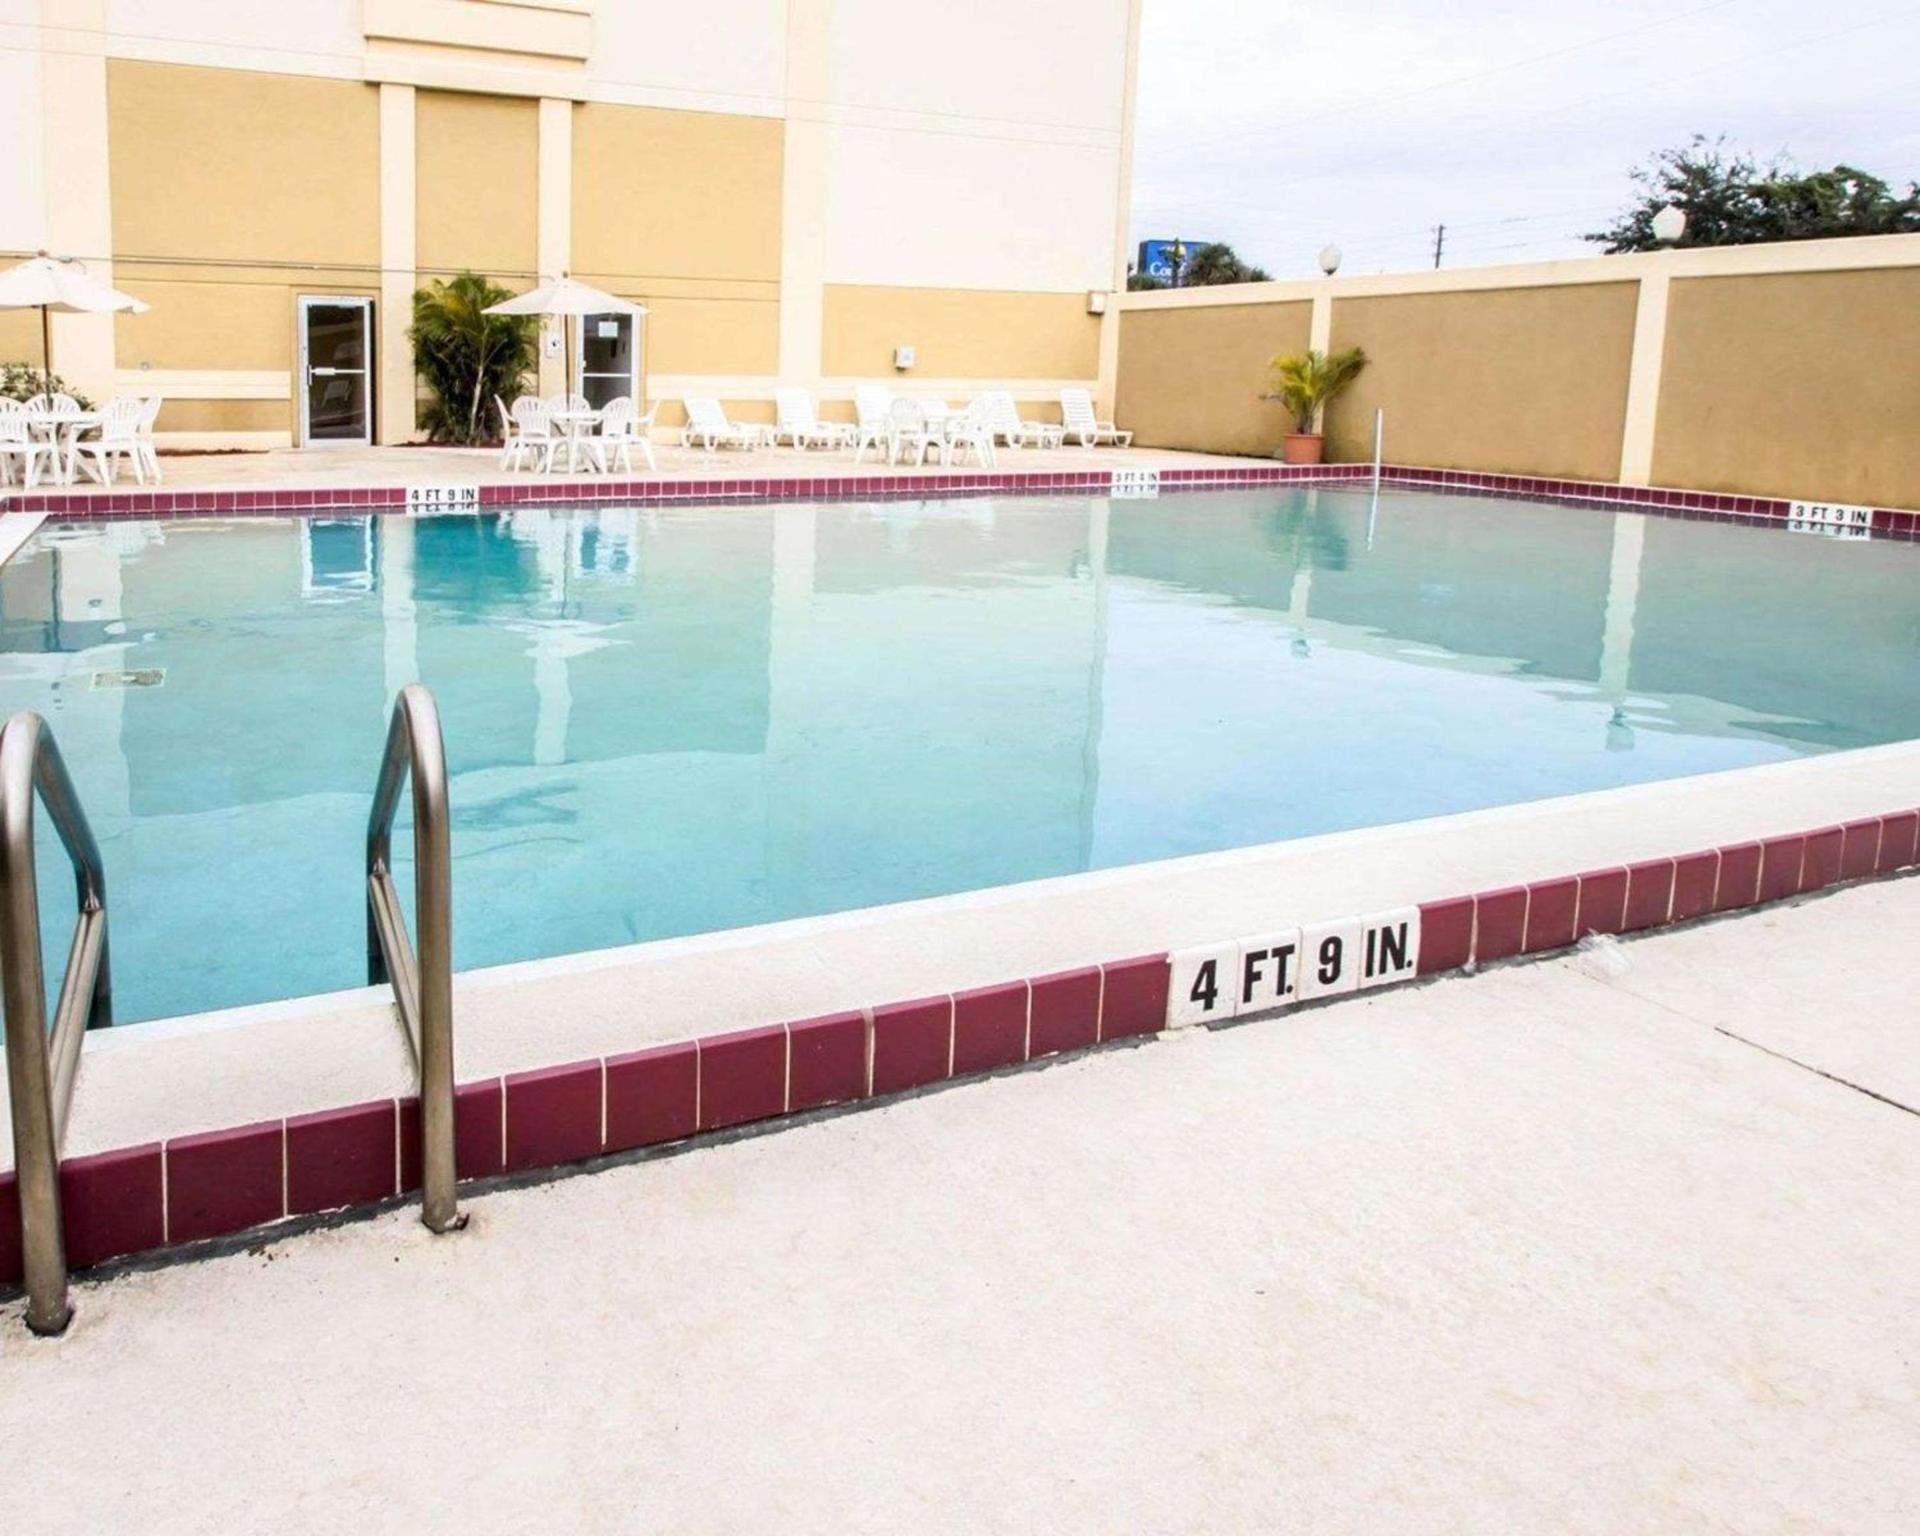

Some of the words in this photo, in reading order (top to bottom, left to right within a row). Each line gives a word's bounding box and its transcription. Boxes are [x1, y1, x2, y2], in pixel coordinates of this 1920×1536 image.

[412, 490, 419, 501] 4
[448, 489, 455, 501] 9
[1796, 505, 1804, 517] 3
[1835, 509, 1844, 521] 3
[1190, 959, 1218, 1011] 4
[1242, 944, 1295, 1004] FT.
[1318, 936, 1343, 985] 9
[1365, 922, 1413, 978] IN.
